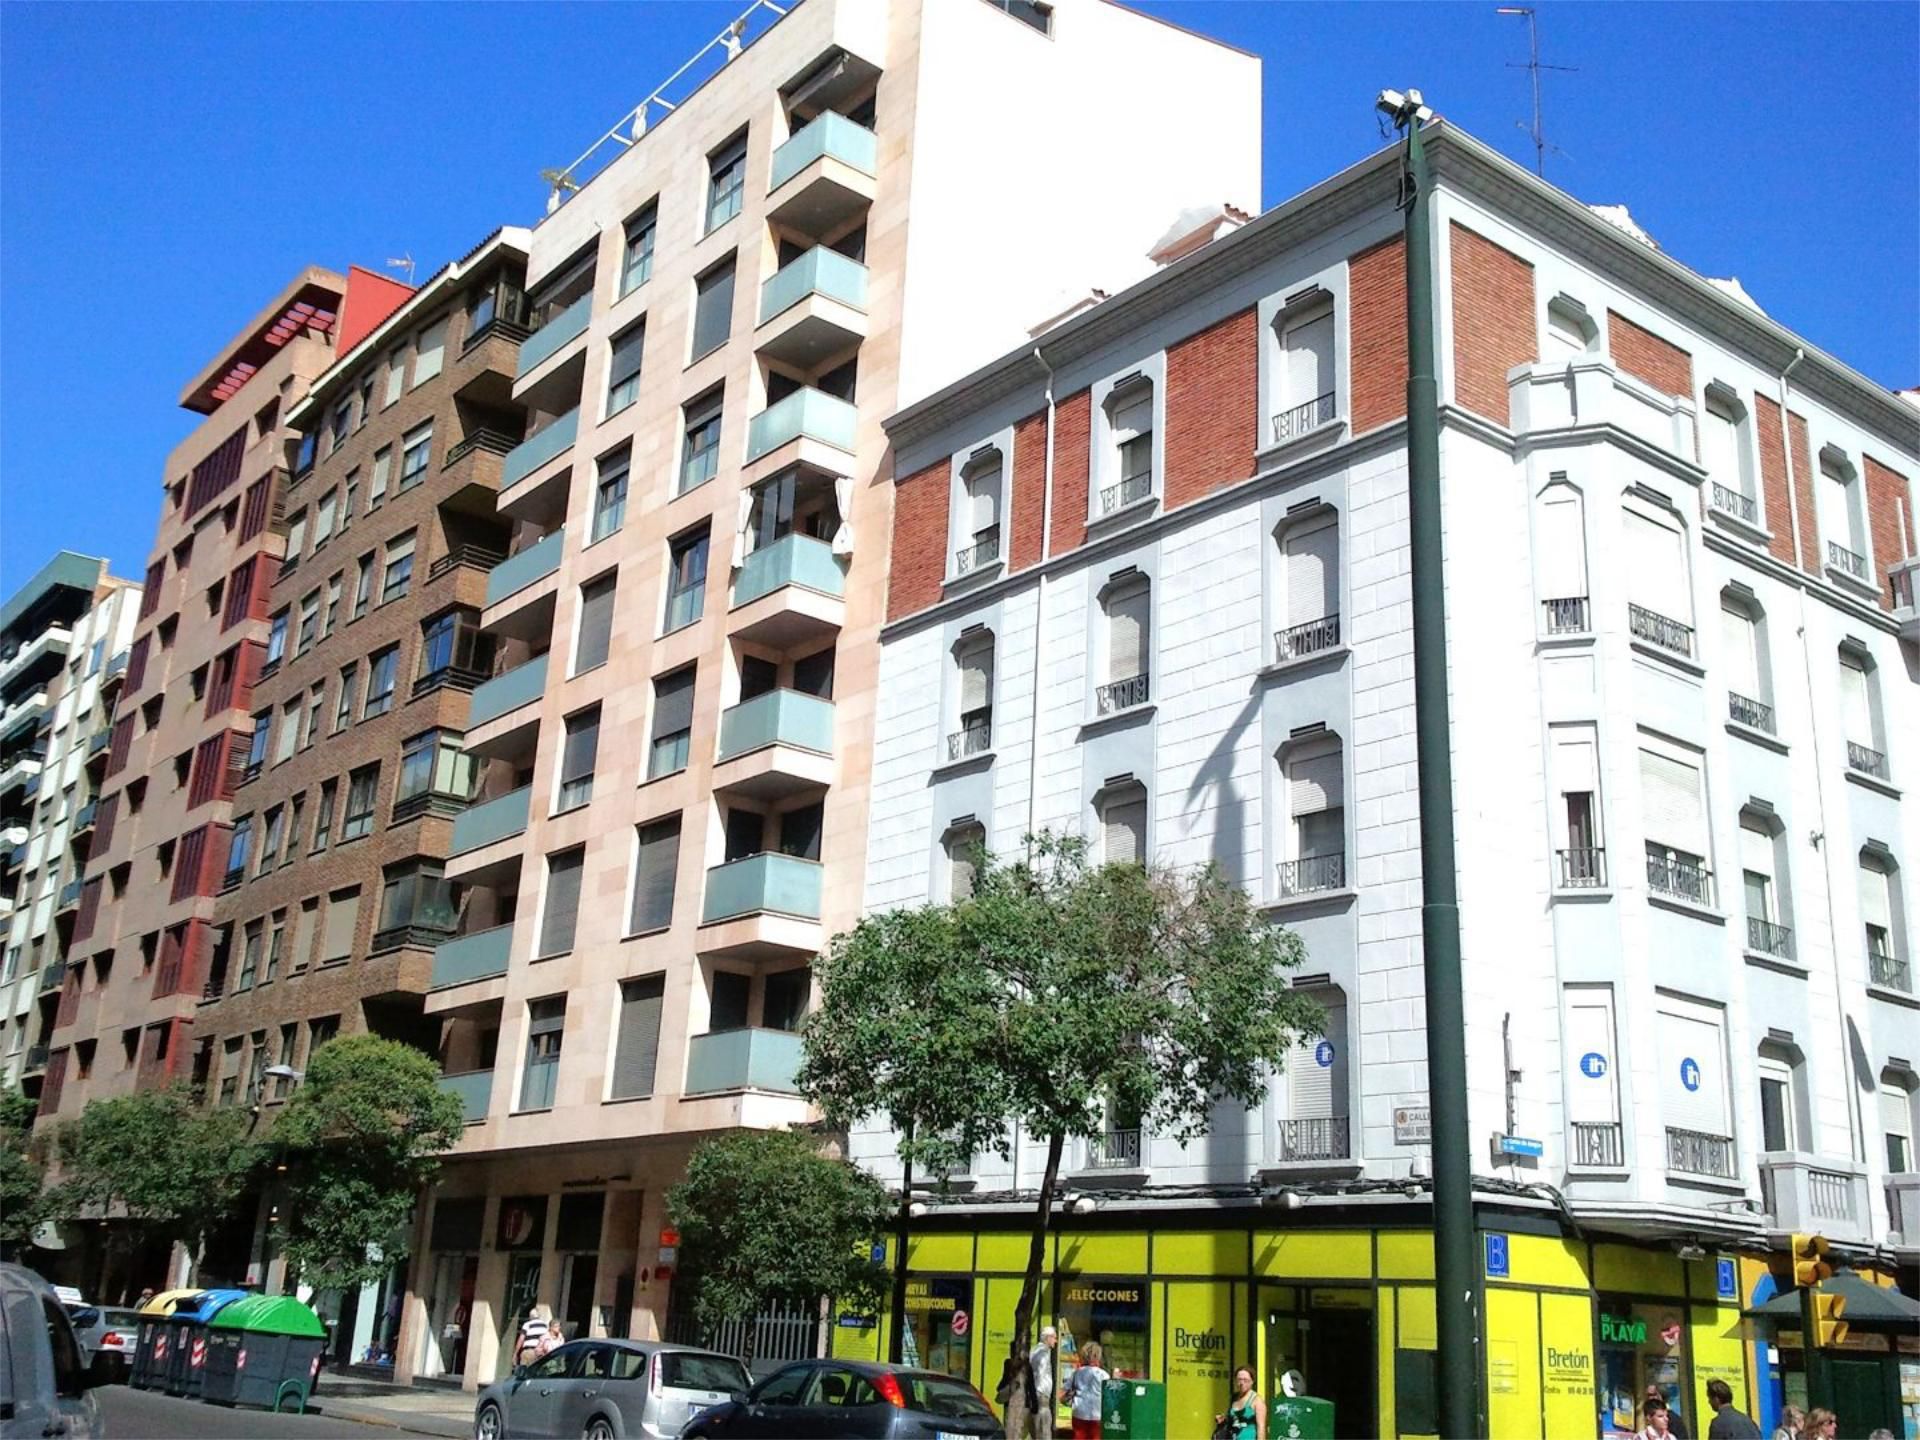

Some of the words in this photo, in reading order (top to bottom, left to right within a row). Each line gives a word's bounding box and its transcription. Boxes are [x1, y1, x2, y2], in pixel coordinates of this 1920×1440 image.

[1175, 1326, 1226, 1350] Bretón
[1601, 1322, 1647, 1344] PLAYA
[1547, 1346, 1589, 1369] Bretón
